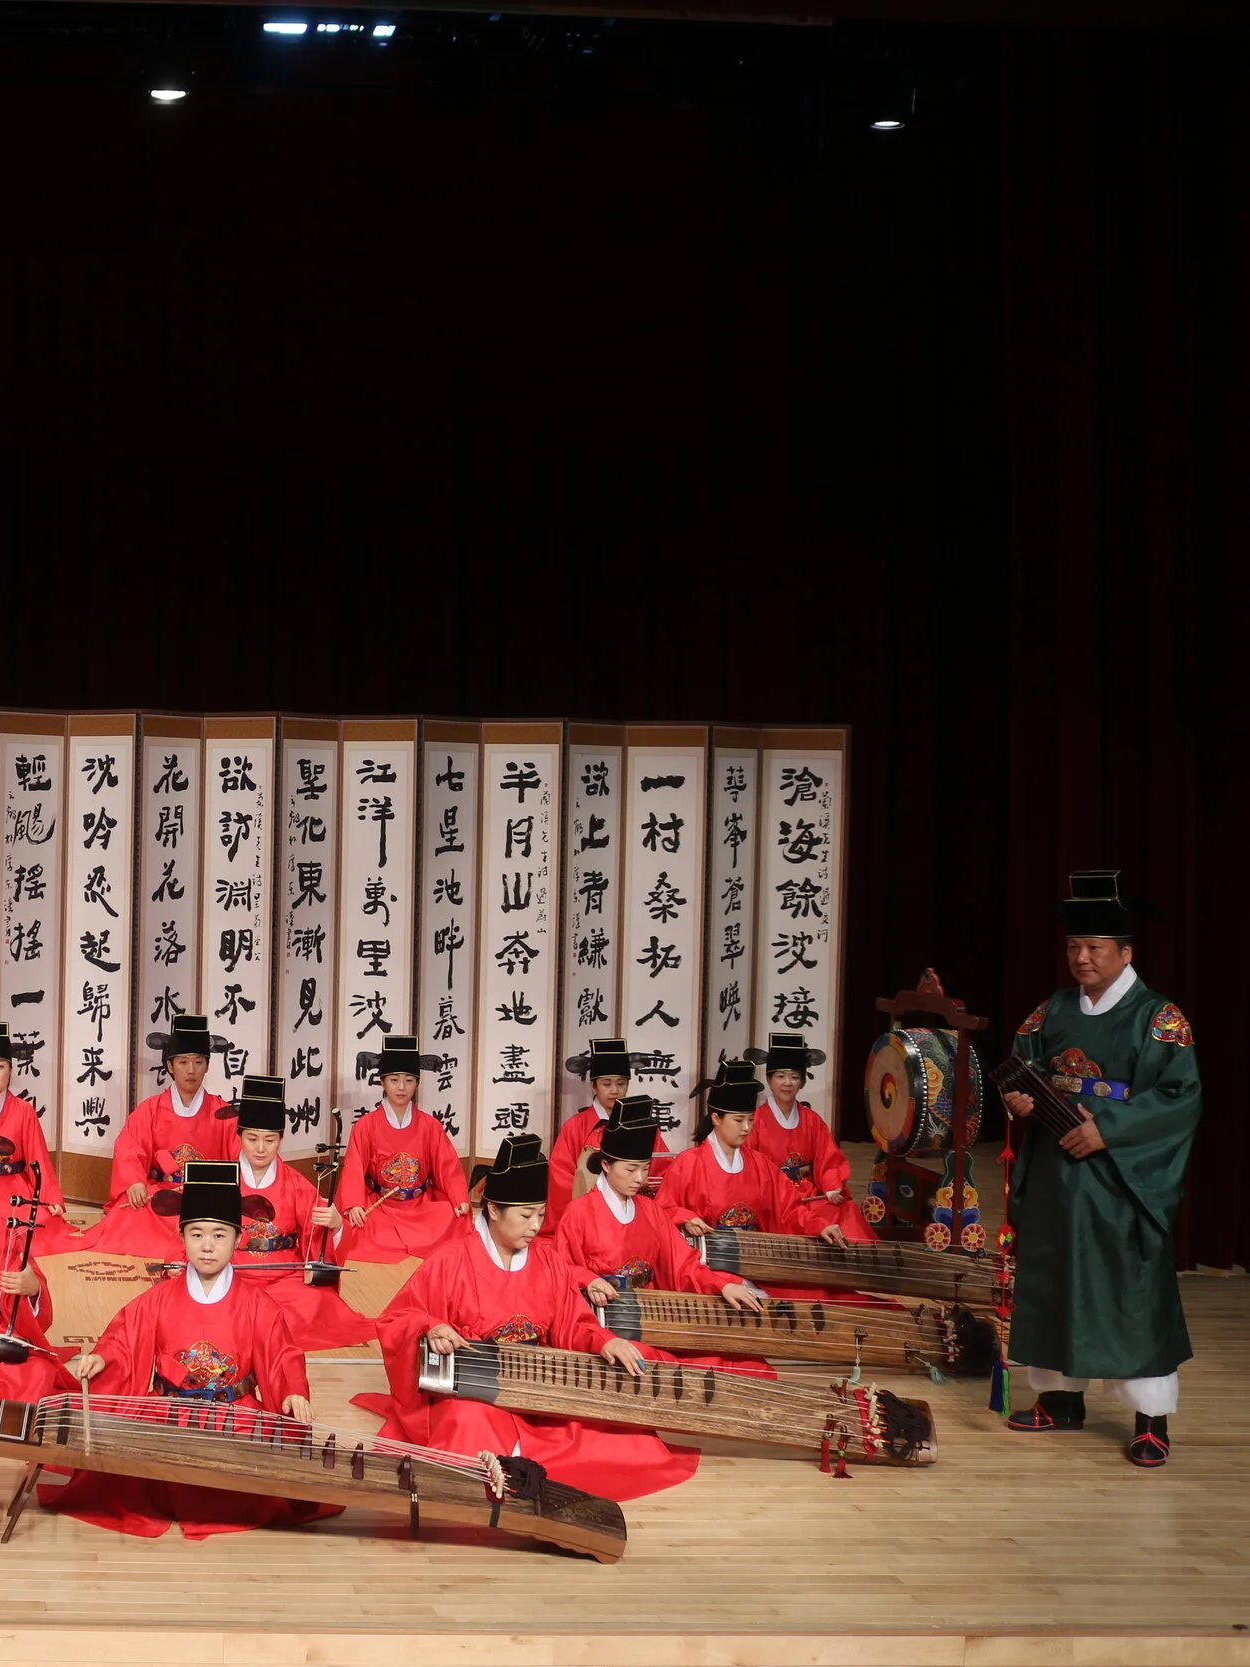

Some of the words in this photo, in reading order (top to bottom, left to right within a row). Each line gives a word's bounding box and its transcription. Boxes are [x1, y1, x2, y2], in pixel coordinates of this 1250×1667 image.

[215, 756, 256, 1104] 欲訪淵明不自
[771, 767, 823, 1079] 滄海餘波接
